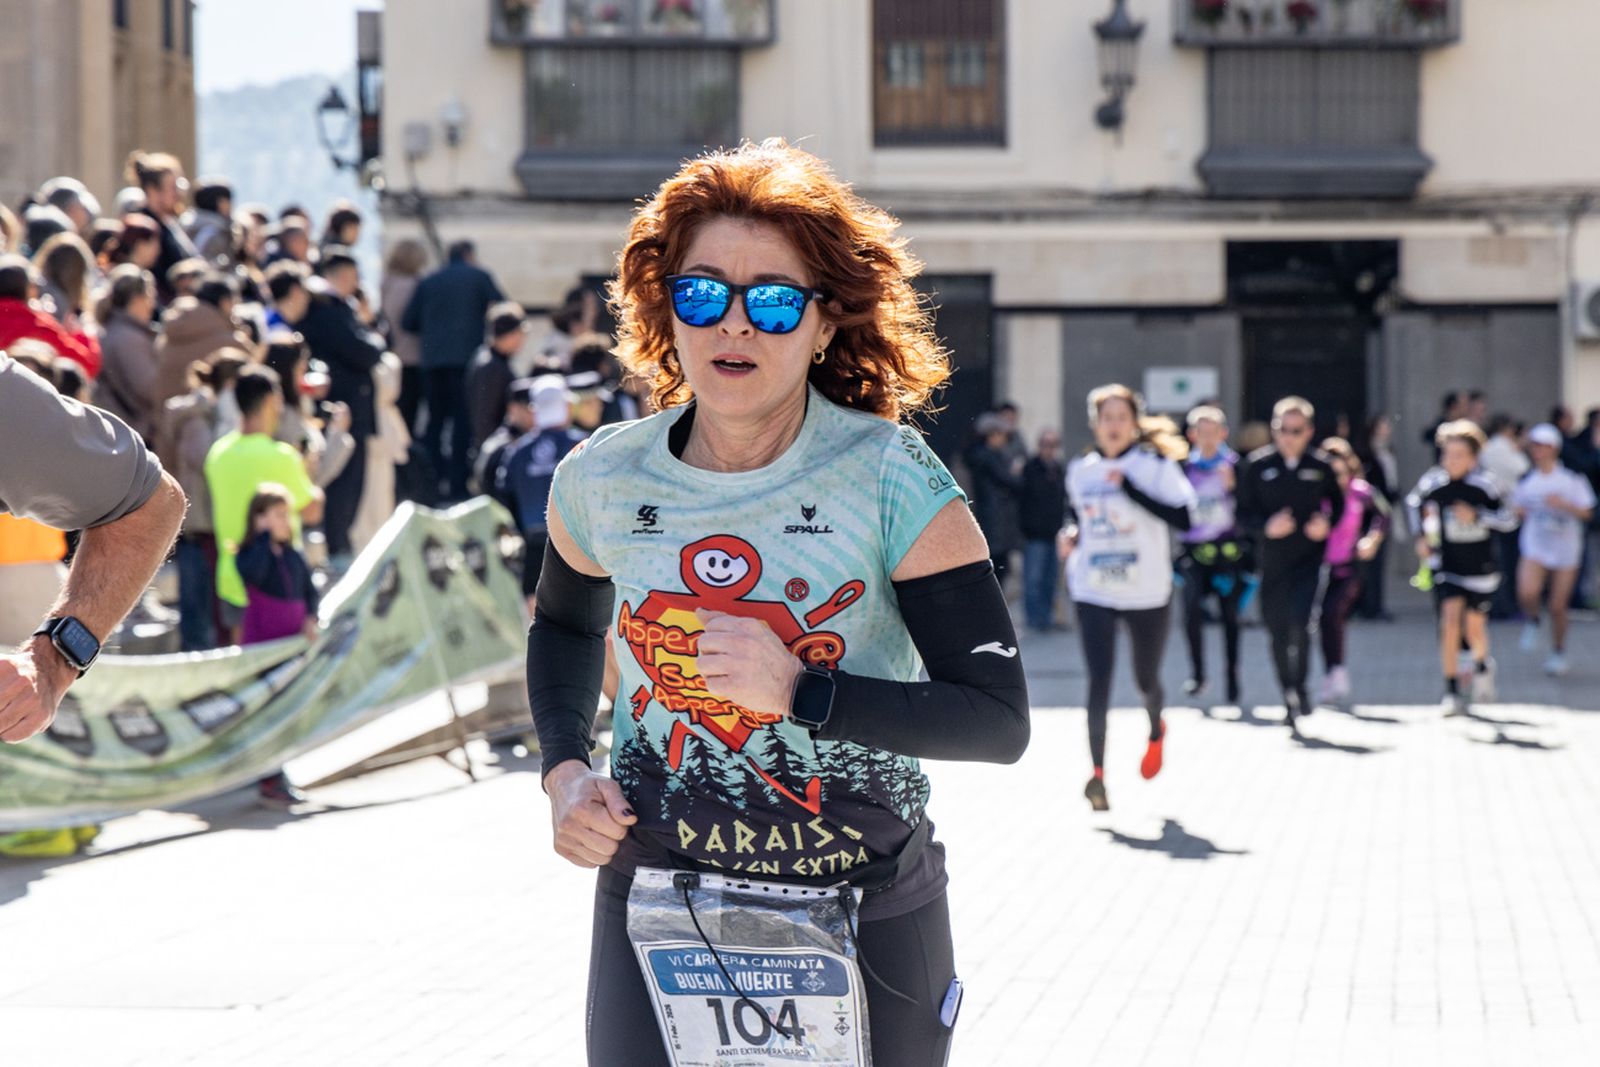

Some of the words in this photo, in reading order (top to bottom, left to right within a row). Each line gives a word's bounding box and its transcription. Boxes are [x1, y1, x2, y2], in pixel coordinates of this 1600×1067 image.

[783, 525, 834, 535] SPALL
[653, 683, 783, 730] Asperge
[792, 847, 870, 876] EXTRA
[667, 955, 682, 966] VI
[751, 957, 825, 970] CAMINATA
[674, 972, 726, 991] BUENA
[729, 971, 794, 991] MUERTE
[706, 997, 806, 1047] 104
[716, 1048, 739, 1056] SANTI
